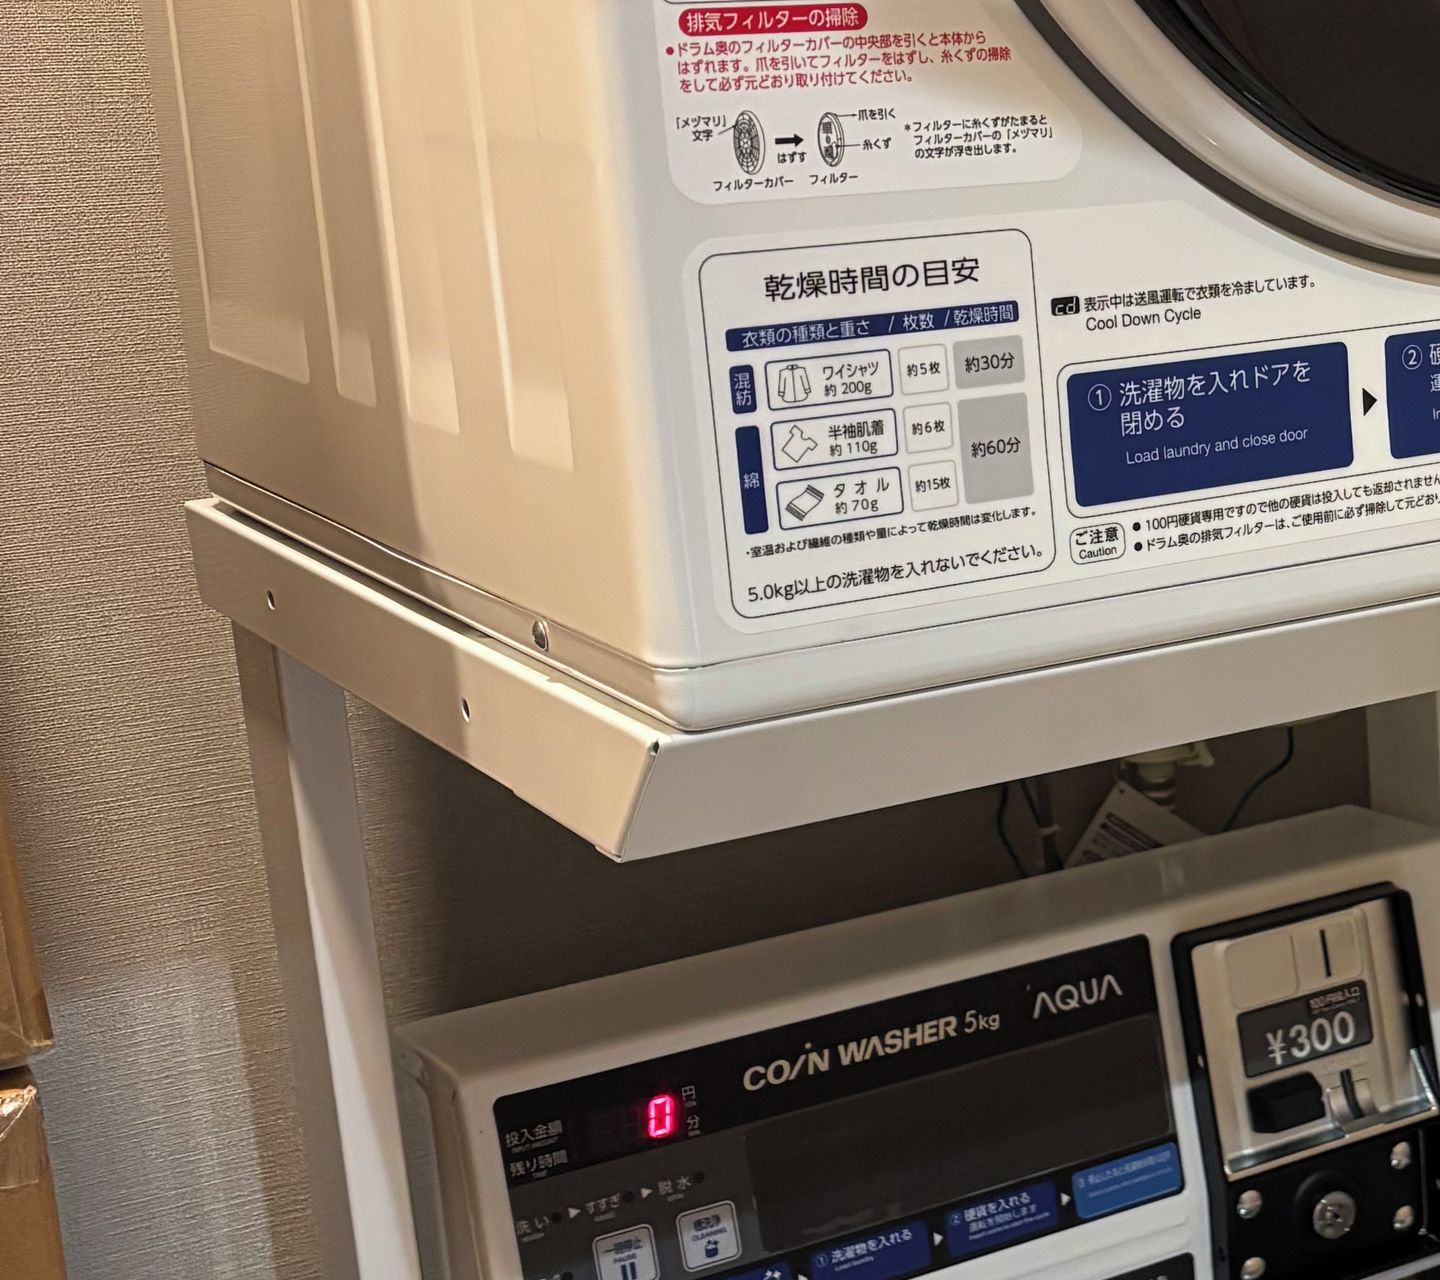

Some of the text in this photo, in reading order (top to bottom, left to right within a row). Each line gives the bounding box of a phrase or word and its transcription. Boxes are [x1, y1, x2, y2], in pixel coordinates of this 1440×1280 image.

[687, 8, 859, 33] 排気フィルターの掃除
[858, 107, 895, 121] 爪を引く
[692, 129, 713, 142] 文字
[863, 137, 891, 151] 糸くず
[777, 151, 806, 164] はずす
[714, 178, 793, 193] フィルターカバー
[810, 171, 858, 184] フィルター
[764, 257, 980, 302] 乾燥時間の目安
[1086, 307, 1201, 332] Cool Down Cycle
[742, 315, 935, 348] 衣類の種類と重さ 枚数
[822, 361, 880, 379] ワイシャツ
[964, 352, 1015, 373] 約30分
[733, 372, 752, 407] 混紡
[1119, 361, 1311, 407] 洗濯物を入れドアを
[828, 420, 884, 440] 半袖肌着
[1121, 407, 1185, 436] 閉める
[971, 437, 1021, 458] 約60分
[1126, 428, 1308, 465] Load laundry and close door
[744, 472, 759, 489] 綿
[915, 476, 950, 493] 約15枚
[1074, 526, 1120, 546] ご注意
[1078, 545, 1117, 561] Caution
[742, 973, 1122, 1092] COIN WASHER 5kg AQUA
[1266, 1011, 1356, 1066] ¥300
[647, 1094, 673, 1139] 0
